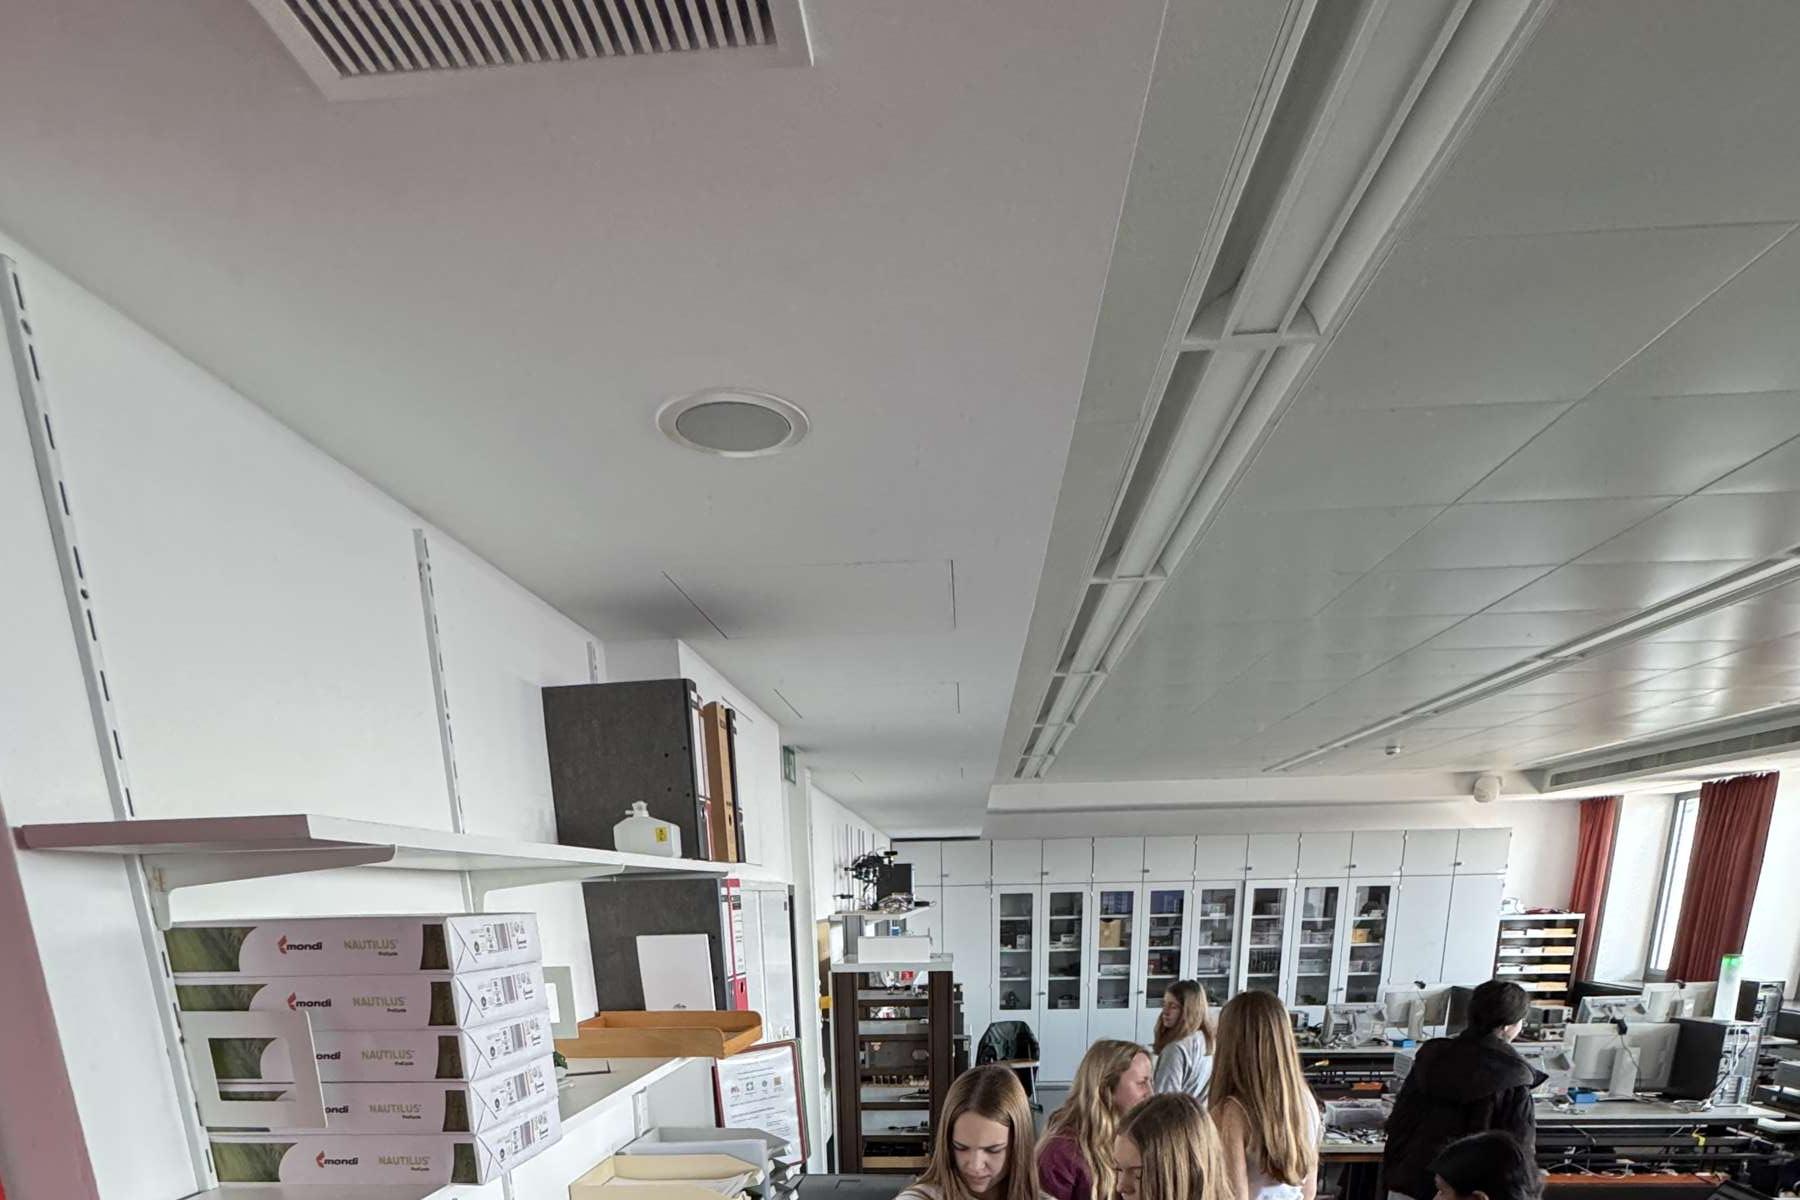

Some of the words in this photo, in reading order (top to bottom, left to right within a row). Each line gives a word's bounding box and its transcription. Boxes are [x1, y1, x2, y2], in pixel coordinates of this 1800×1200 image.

[286, 941, 323, 951] mondi
[295, 998, 332, 1008] mondi
[315, 1051, 342, 1061] ondi
[361, 1049, 413, 1061] NAUTILUS
[325, 1105, 350, 1114] ondi
[369, 1103, 420, 1114] NAUTILUS
[324, 1156, 359, 1166] mondi
[378, 1155, 429, 1166] NAUTILUS
